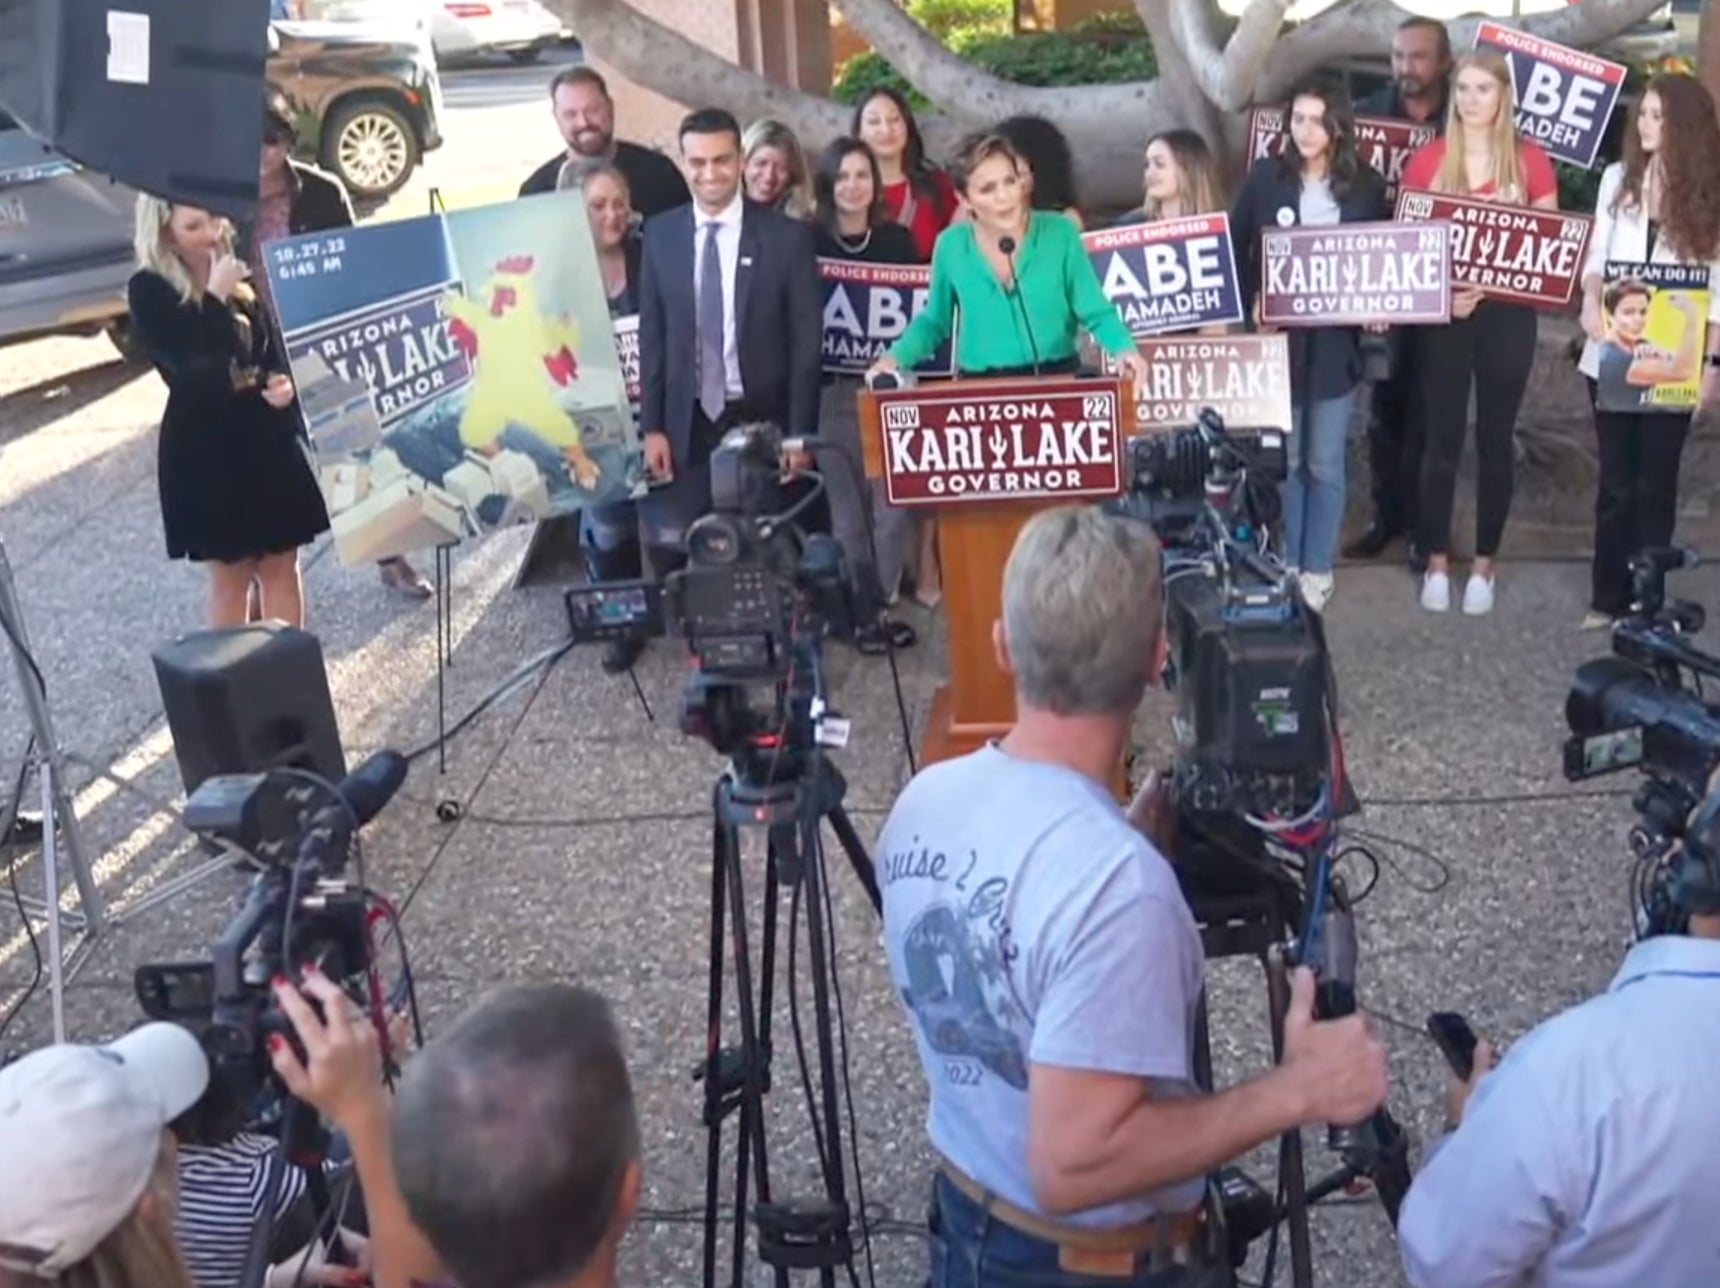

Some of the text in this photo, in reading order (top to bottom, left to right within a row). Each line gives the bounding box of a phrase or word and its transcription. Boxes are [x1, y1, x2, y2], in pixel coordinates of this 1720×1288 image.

[1496, 32, 1606, 75] POLICE ENDORSED
[1406, 197, 1434, 218] NOV
[1452, 207, 1539, 233] ARIZONA
[1095, 220, 1210, 248] POLICE ENDORSED
[1311, 235, 1397, 253] ARIZONA
[323, 255, 342, 273] AM
[1102, 235, 1224, 302] ABE
[1493, 230, 1579, 278] LAKE
[822, 265, 869, 280] POLICE
[1266, 252, 1441, 295] KARI LAKE
[1453, 264, 1543, 292] VERNOR
[1633, 264, 1661, 281] CAN
[1665, 268, 1686, 281] DO
[1292, 294, 1414, 314] GOVERNOR
[1154, 344, 1240, 360] ARIZONA
[381, 371, 445, 413] RNOR
[1204, 361, 1282, 400] LAKE
[888, 397, 1110, 428] NOV ARIZONA 22
[889, 420, 1113, 475] KARI LAKE
[928, 469, 1082, 495] GOVERNOR
